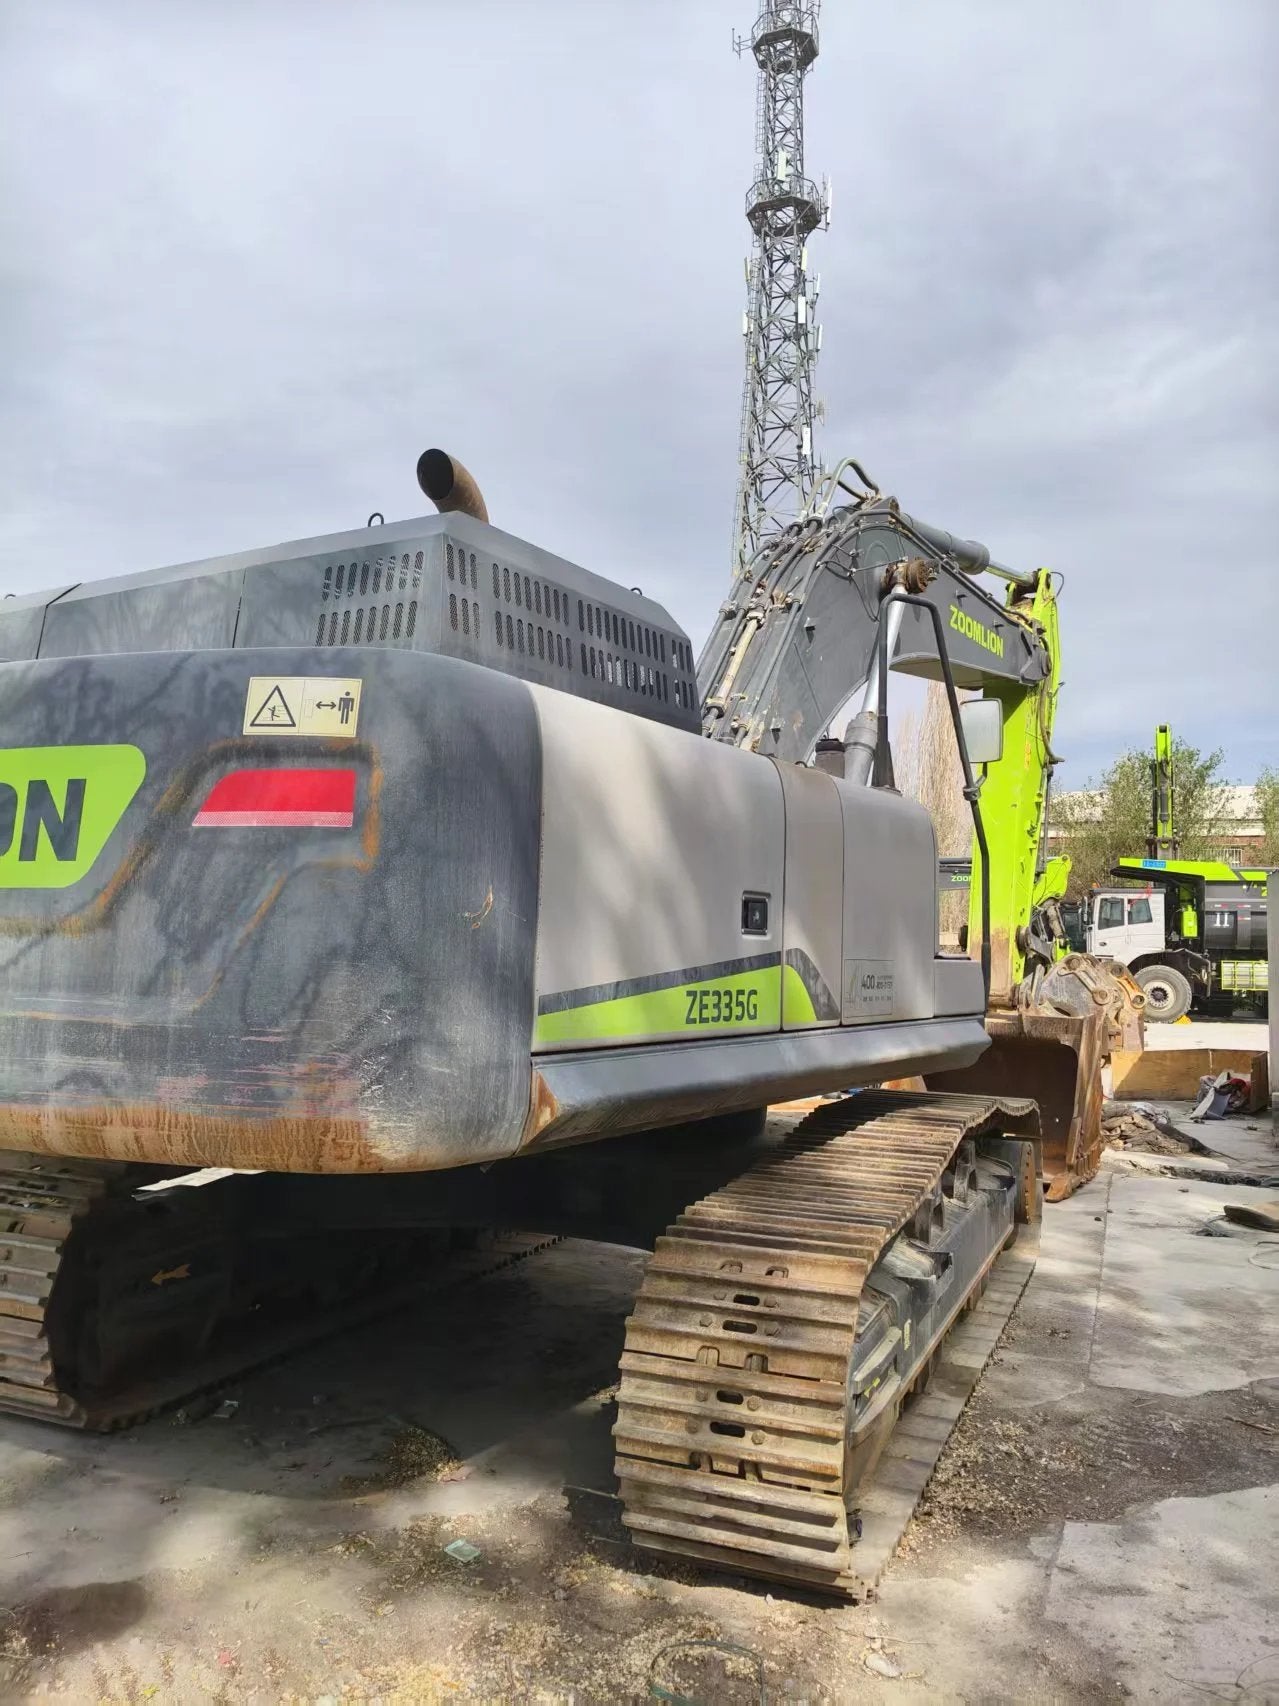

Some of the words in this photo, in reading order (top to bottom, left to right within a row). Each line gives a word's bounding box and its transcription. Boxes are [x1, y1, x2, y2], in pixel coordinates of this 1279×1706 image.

[950, 604, 1004, 659] ZOOMLION
[862, 974, 875, 990] 400
[685, 988, 758, 1025] ZE335G
